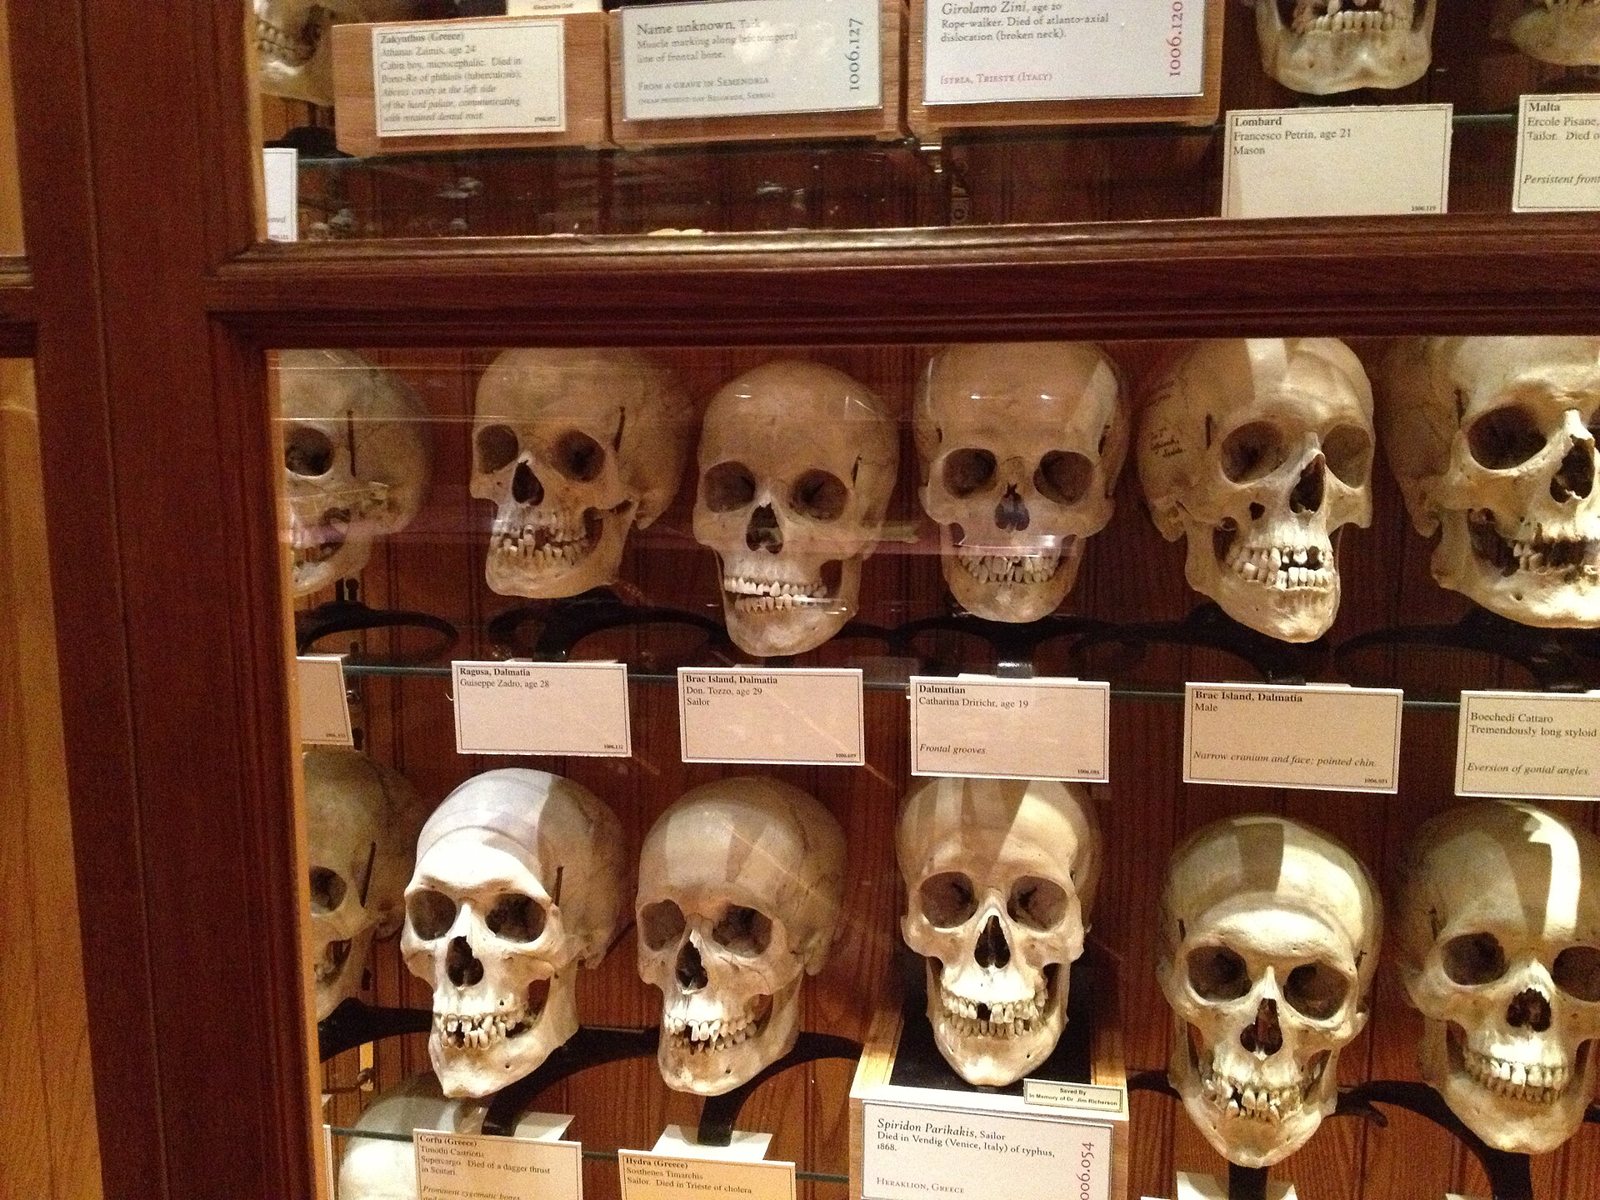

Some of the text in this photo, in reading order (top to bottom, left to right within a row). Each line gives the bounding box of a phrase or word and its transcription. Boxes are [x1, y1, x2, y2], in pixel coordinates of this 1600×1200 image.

[942, 3, 997, 15] Girolamo
[1032, 5, 1047, 13] age
[1007, 17, 1031, 26] Died
[1033, 16, 1043, 25] of
[1046, 14, 1109, 24] atlanto-axial
[637, 23, 672, 35] Name
[427, 32, 465, 43] (Greece)
[941, 32, 993, 43] dislocation
[996, 31, 1033, 42] (broken
[1166, 1, 1183, 77] 1006.120
[656, 52, 666, 62] of
[848, 18, 863, 91] 1006.127
[1529, 103, 1561, 112] Malta
[1235, 117, 1282, 127] Lombard
[1528, 117, 1559, 126] Ercole
[1234, 132, 1281, 141] Francesco
[1320, 131, 1336, 139] age
[1340, 129, 1351, 138] 21
[1527, 132, 1557, 140] Tailor.
[1566, 132, 1590, 140] Died
[1233, 146, 1265, 156] Mason
[1524, 174, 1574, 184] Persistent
[460, 668, 530, 677] Ragusa, Dalmatia
[460, 680, 495, 688] Guiseppe
[498, 680, 522, 688] Zadro,
[540, 680, 549, 688] 28
[686, 675, 778, 684] Brac Island, Dalmatia
[708, 687, 734, 695] Tozzo,
[919, 685, 966, 694] Dalmatian
[1195, 690, 1303, 702] Brac Island, Dalmatia
[687, 698, 710, 706] Sailor
[919, 697, 959, 706] Catharina
[1001, 701, 1015, 709] age
[1019, 700, 1029, 708] 19
[1195, 703, 1218, 712] Male
[1518, 714, 1553, 723] Cattaro
[1470, 725, 1597, 738] Tremendously long styloid
[920, 744, 951, 753] Frontal
[1194, 751, 1227, 761] Narrow
[1231, 753, 1268, 762] cranium
[1271, 755, 1289, 763] and
[1316, 757, 1352, 767] pointed
[1468, 763, 1509, 772] Eversion
[1512, 764, 1522, 774] of
[1524, 766, 1555, 775] gonial
[877, 1118, 1006, 1140] Spiridon Parikakis, Sailor
[420, 1136, 477, 1147] Corfu (Greece)
[878, 1132, 1055, 1158] Died in Vendig (Venice, Italy) of typhus,
[877, 1143, 897, 1152] 1868.
[626, 1158, 688, 1169] Hydra (Greece)
[503, 1164, 527, 1173] dagger
[529, 1166, 550, 1174] thrust
[656, 1179, 674, 1187] Died
[686, 1182, 712, 1191] Trieste
[724, 1185, 752, 1194] cholera
